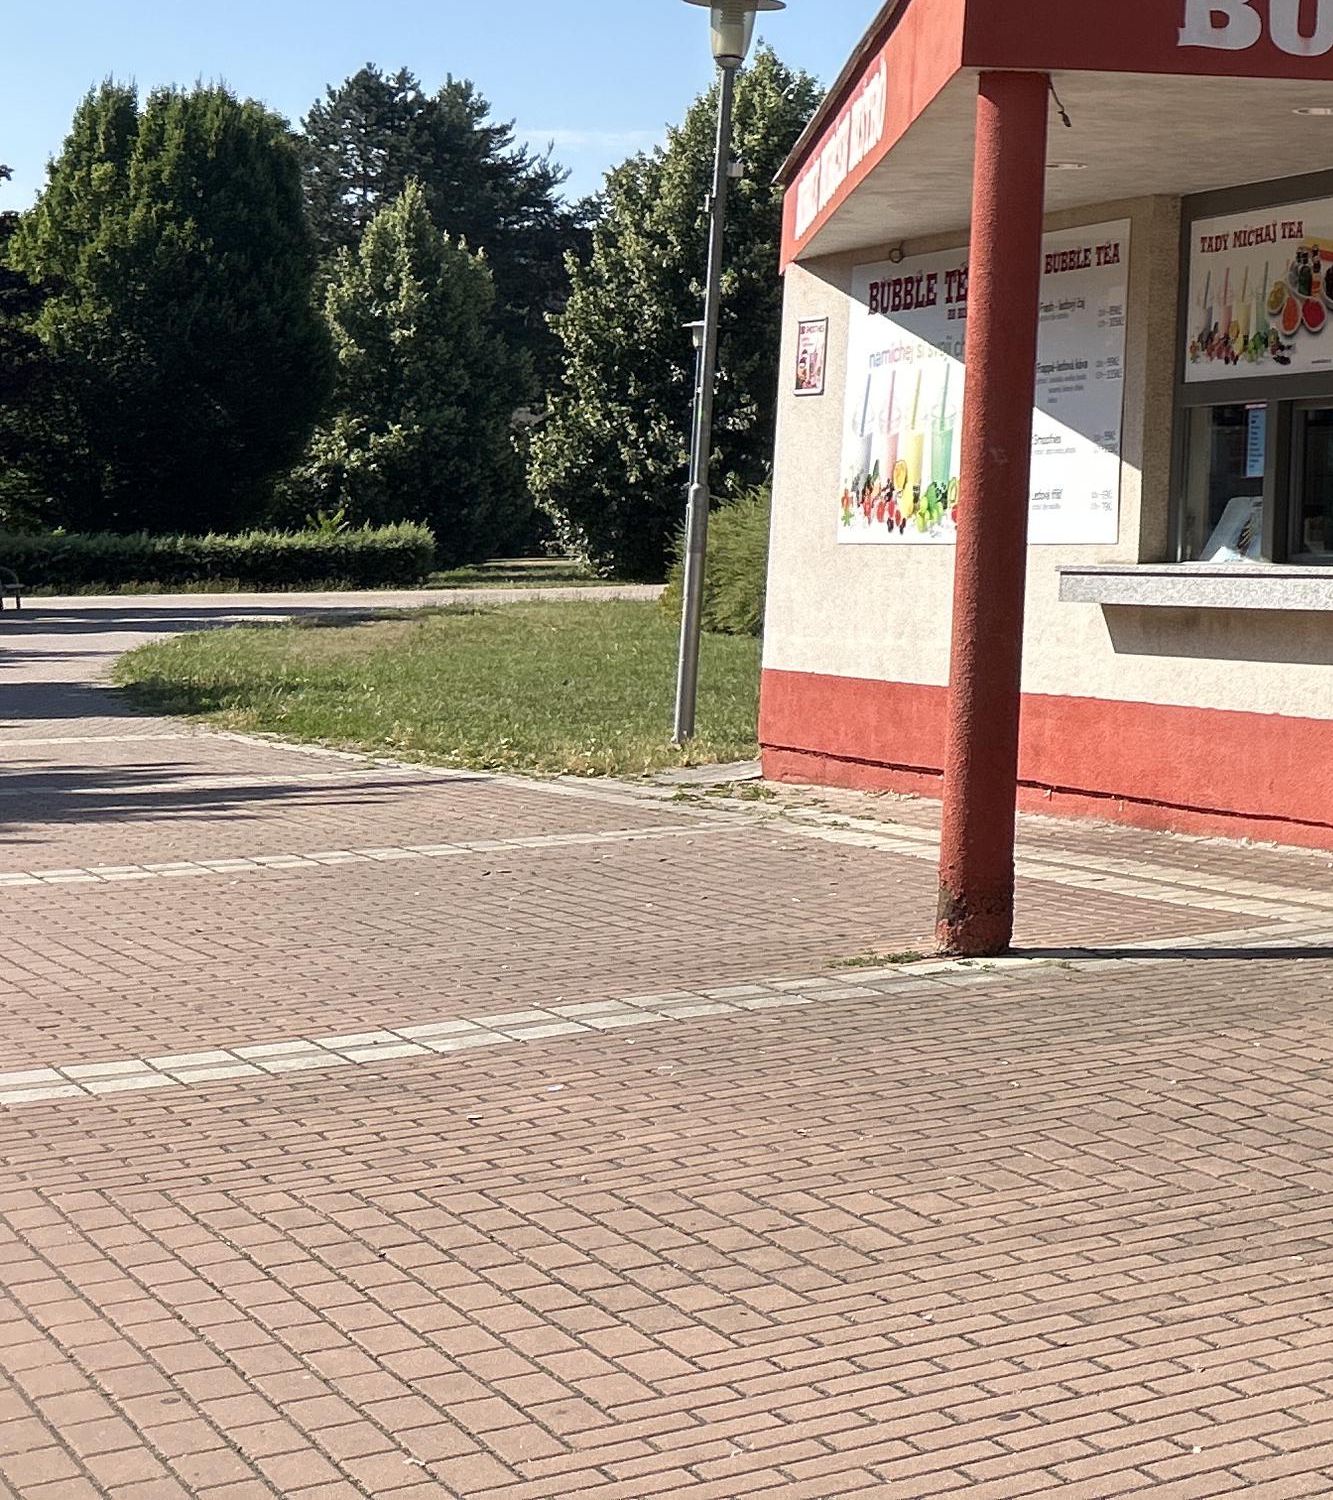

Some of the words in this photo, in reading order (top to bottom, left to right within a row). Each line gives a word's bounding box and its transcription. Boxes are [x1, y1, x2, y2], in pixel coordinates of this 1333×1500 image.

[1200, 234, 1229, 253] TADY
[1281, 221, 1303, 239] TEA
[1044, 247, 1091, 275] BUBBLE
[1096, 242, 1120, 267] TEA
[867, 271, 938, 316] BUBBLE
